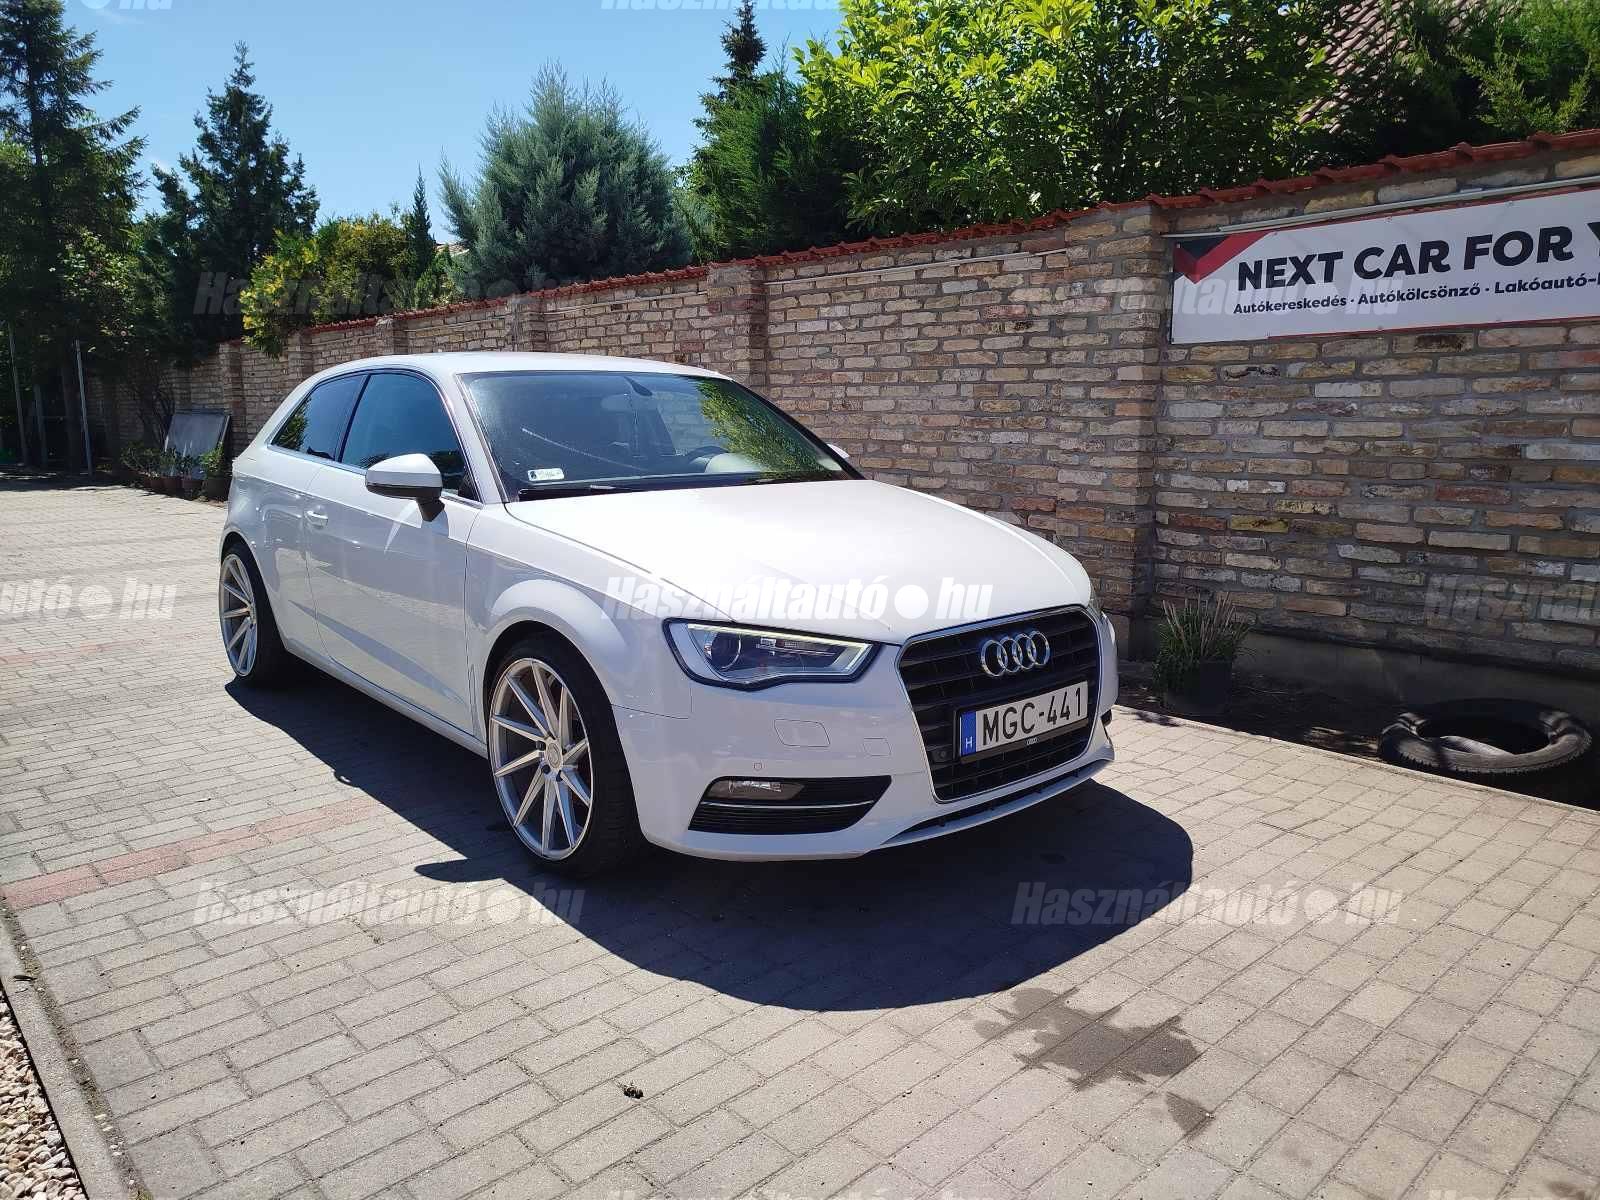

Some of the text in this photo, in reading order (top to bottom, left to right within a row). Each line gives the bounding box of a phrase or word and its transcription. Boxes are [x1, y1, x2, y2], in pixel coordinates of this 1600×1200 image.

[1237, 249, 1344, 292] NEXT
[1352, 238, 1451, 281] CAR
[1463, 225, 1575, 271] FOR
[1232, 272, 1600, 315] Autókereskedés Autókölcsönző Lakóautó-
[982, 687, 1082, 746] MGC-441
